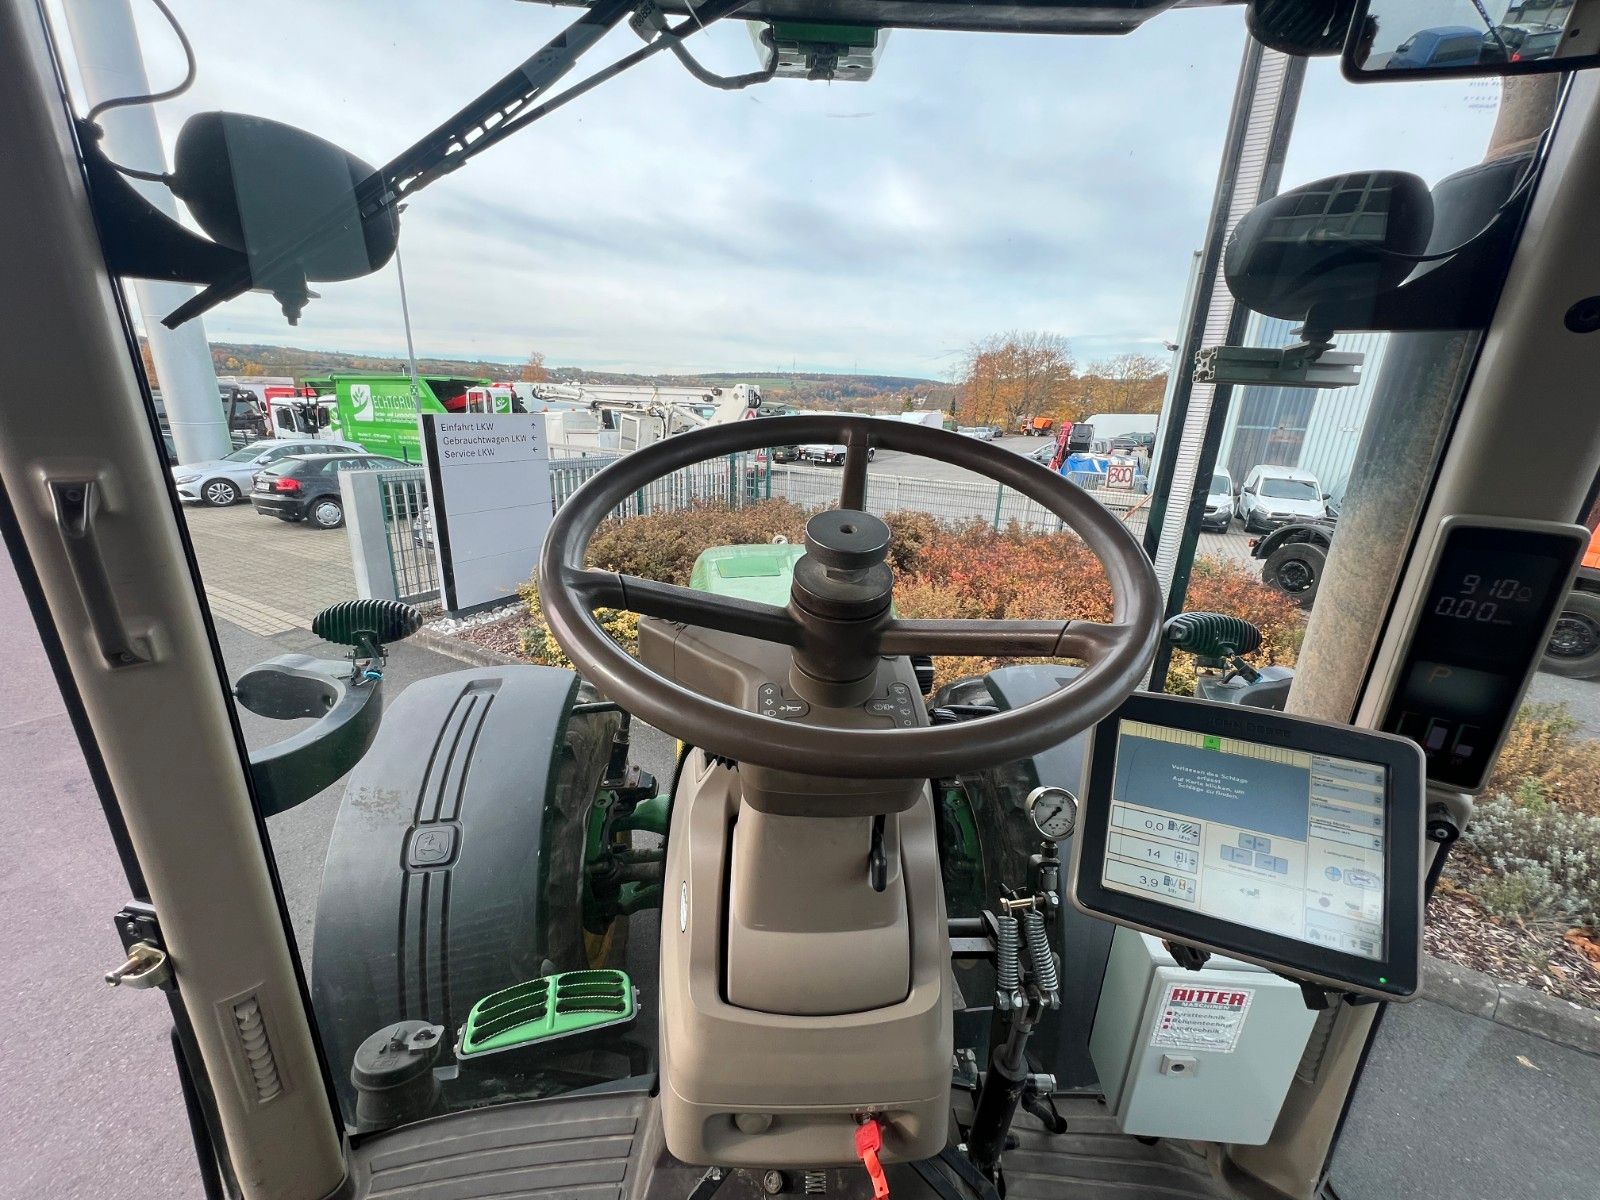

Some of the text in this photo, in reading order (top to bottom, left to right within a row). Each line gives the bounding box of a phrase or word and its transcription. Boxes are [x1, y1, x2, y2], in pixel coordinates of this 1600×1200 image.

[440, 422, 494, 432] Einfahrt LKW
[443, 434, 527, 446] Gebrauchtwagen LKW
[444, 448, 495, 459] Service LKW
[1185, 777, 1204, 787] Karte
[1147, 848, 1160, 859] 14
[1171, 988, 1247, 1006] RITTER
[1182, 1001, 1230, 1011] MASCHINEN
